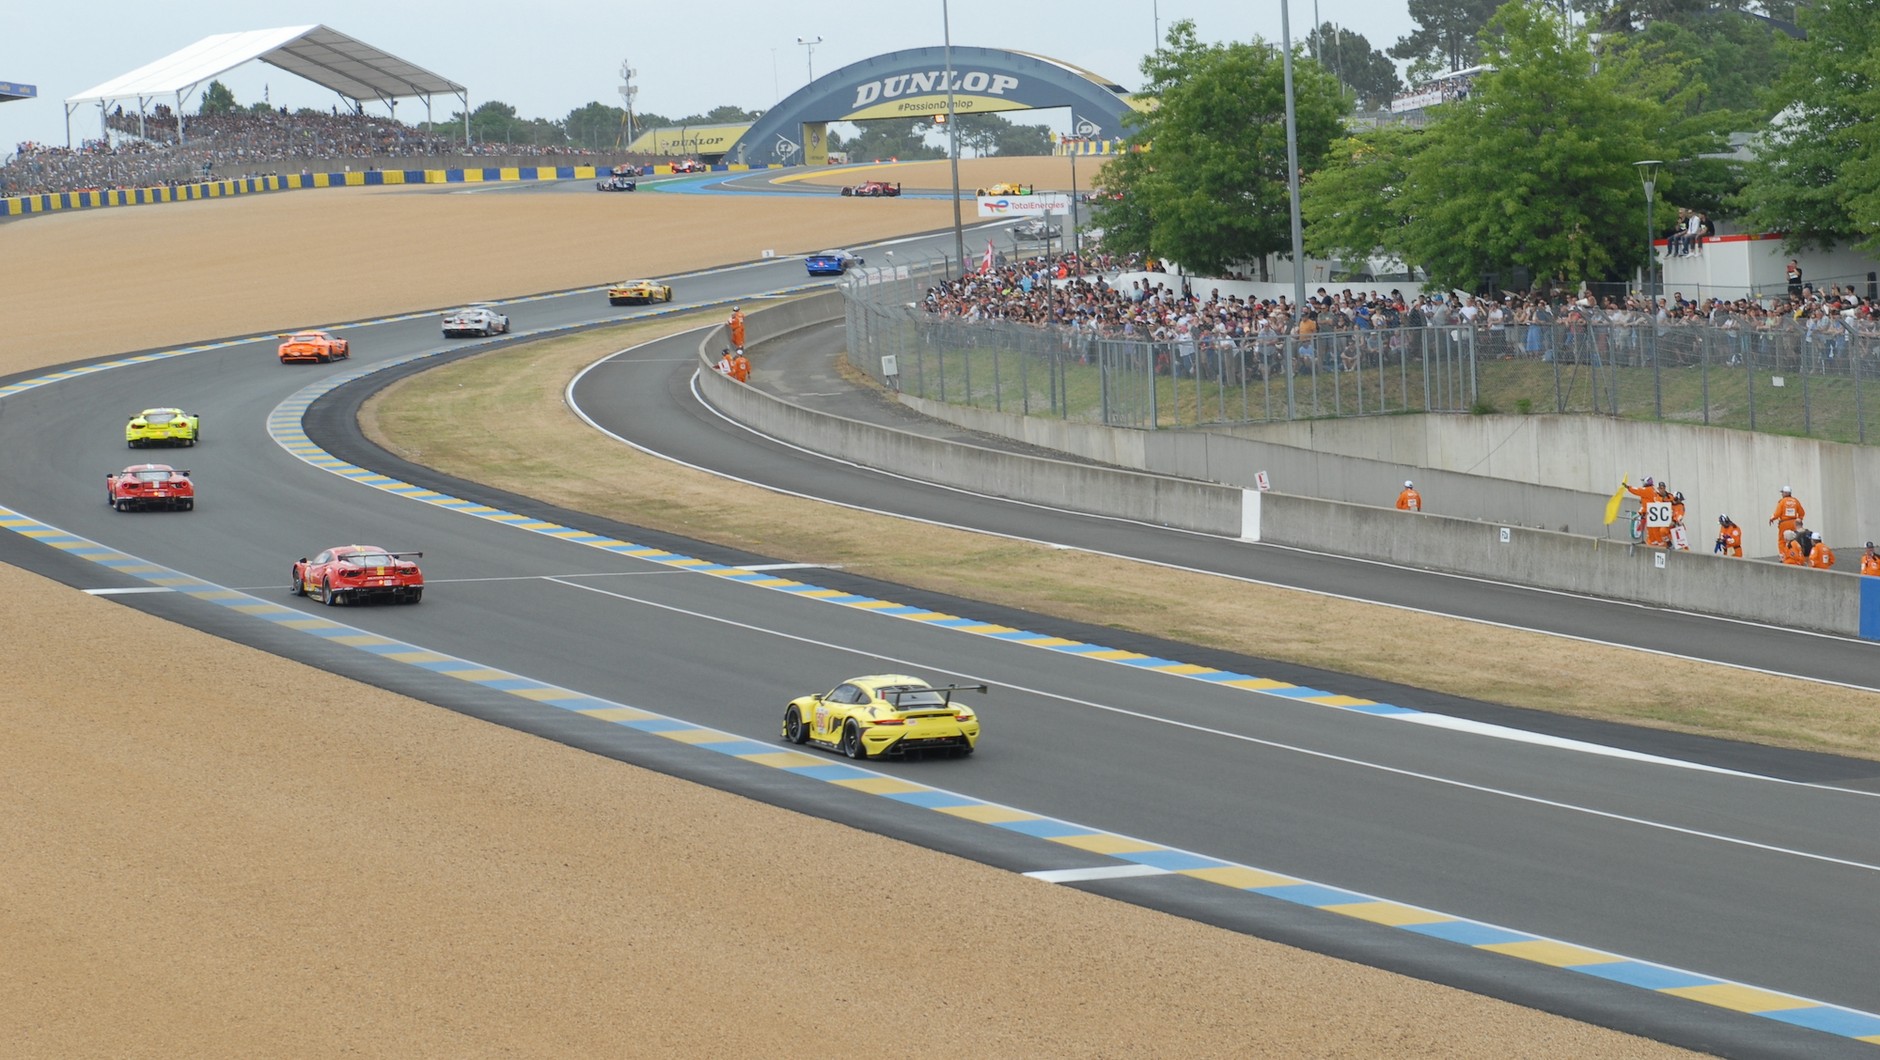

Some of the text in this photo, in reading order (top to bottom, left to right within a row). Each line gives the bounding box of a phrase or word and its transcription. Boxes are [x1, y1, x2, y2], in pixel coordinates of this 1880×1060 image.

[852, 70, 1019, 109] DUNLOP
[672, 137, 724, 147] DUNLOP
[1011, 201, 1065, 211] TotalEnergies
[1649, 506, 1670, 522] SC
